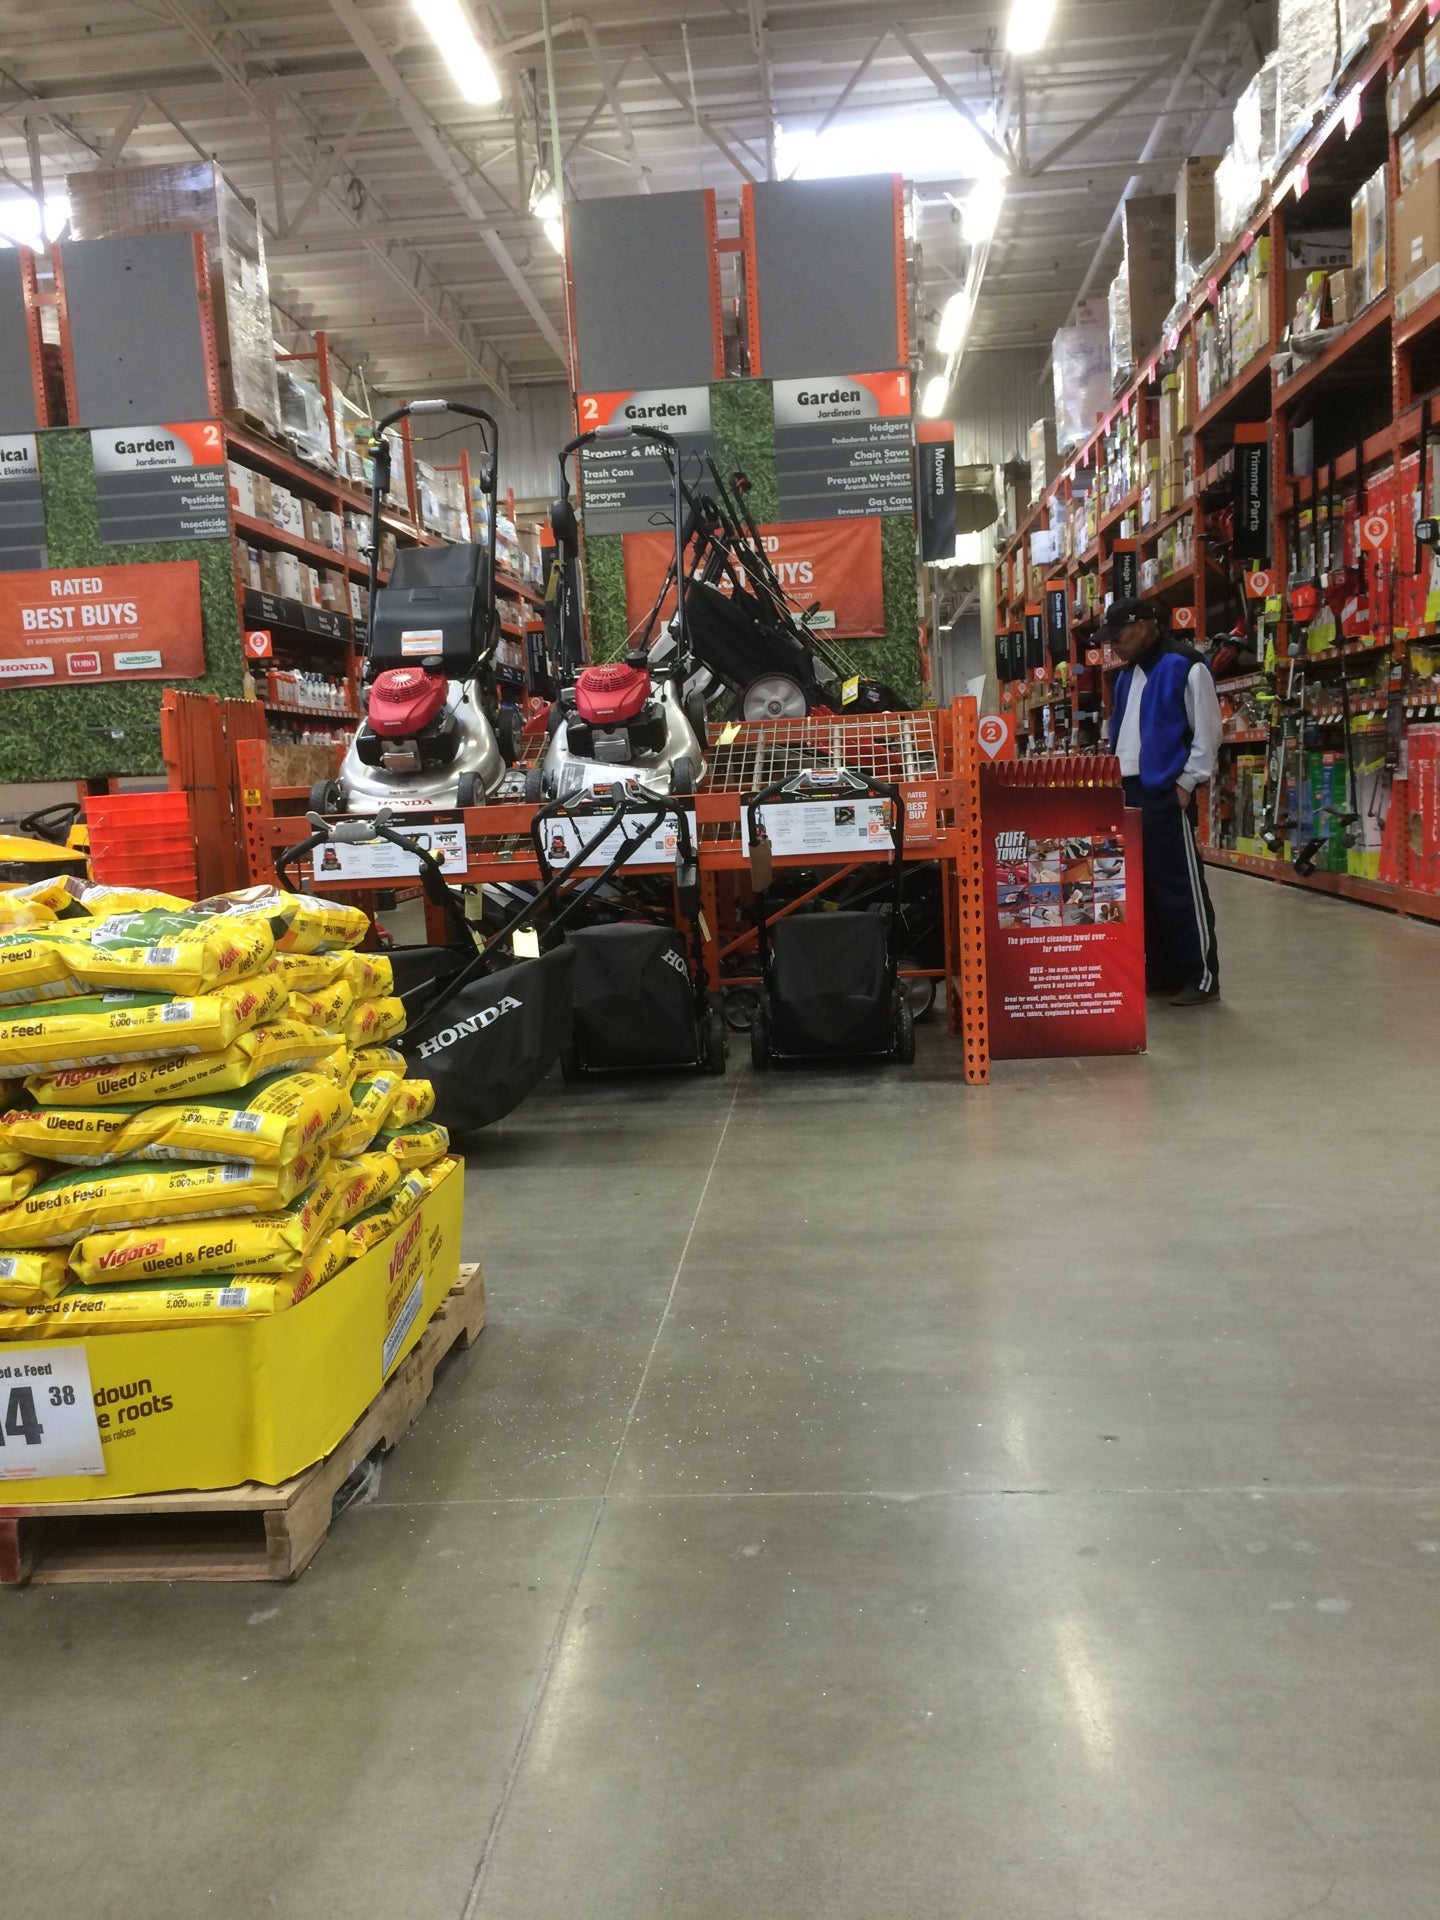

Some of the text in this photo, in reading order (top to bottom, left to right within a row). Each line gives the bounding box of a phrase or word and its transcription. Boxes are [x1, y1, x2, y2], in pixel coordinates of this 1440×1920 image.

[896, 376, 906, 397] 1
[797, 389, 861, 406] Garden
[582, 398, 599, 419] 2
[624, 404, 688, 419] Garden
[869, 422, 909, 433] Hedgers
[203, 425, 219, 446] 2
[114, 438, 175, 454] Garden
[854, 448, 910, 460] Chain Saws
[171, 471, 224, 484] Weed Killer
[583, 468, 634, 479] Trash Cans
[827, 471, 911, 486] Pressure Washers
[934, 447, 946, 496] Mowers
[585, 491, 626, 503] Sprayers
[1250, 449, 1261, 532] Trimmer Parts
[181, 494, 225, 505] Pesticides
[868, 496, 912, 507] Gas Cans
[180, 518, 227, 529] Insecticide
[1372, 525, 1381, 535] 3
[50, 577, 103, 596] RATED
[22, 602, 138, 630] BEST BUYS
[0, 662, 49, 671] HONDA
[72, 659, 95, 668] TORO
[986, 727, 997, 740] 2
[907, 791, 927, 799] RATED
[906, 801, 928, 811] BEST
[909, 810, 927, 820] BUY
[1000, 831, 1026, 848] TUFF
[997, 847, 1028, 861] TOWEL
[109, 1018, 131, 1028] 5,000
[416, 995, 523, 1060] HONDA
[97, 1071, 137, 1096] Weed
[138, 1072, 147, 1084] &
[169, 1078, 188, 1090] down
[188, 1075, 196, 1083] to
[197, 1070, 208, 1081] the
[209, 1063, 227, 1074] roots
[47, 1117, 94, 1132] Weed &
[25, 1195, 62, 1214] Weed
[98, 1241, 165, 1271] Vigoro
[143, 1253, 183, 1273] Weed
[186, 1252, 195, 1264] &
[63, 1303, 71, 1313] &
[166, 1299, 188, 1309] 5,000
[14, 1363, 52, 1377] & Feed
[48, 1385, 76, 1406] 38
[93, 1378, 153, 1408] down
[0, 1386, 44, 1446] 4
[118, 1393, 174, 1424] roots
